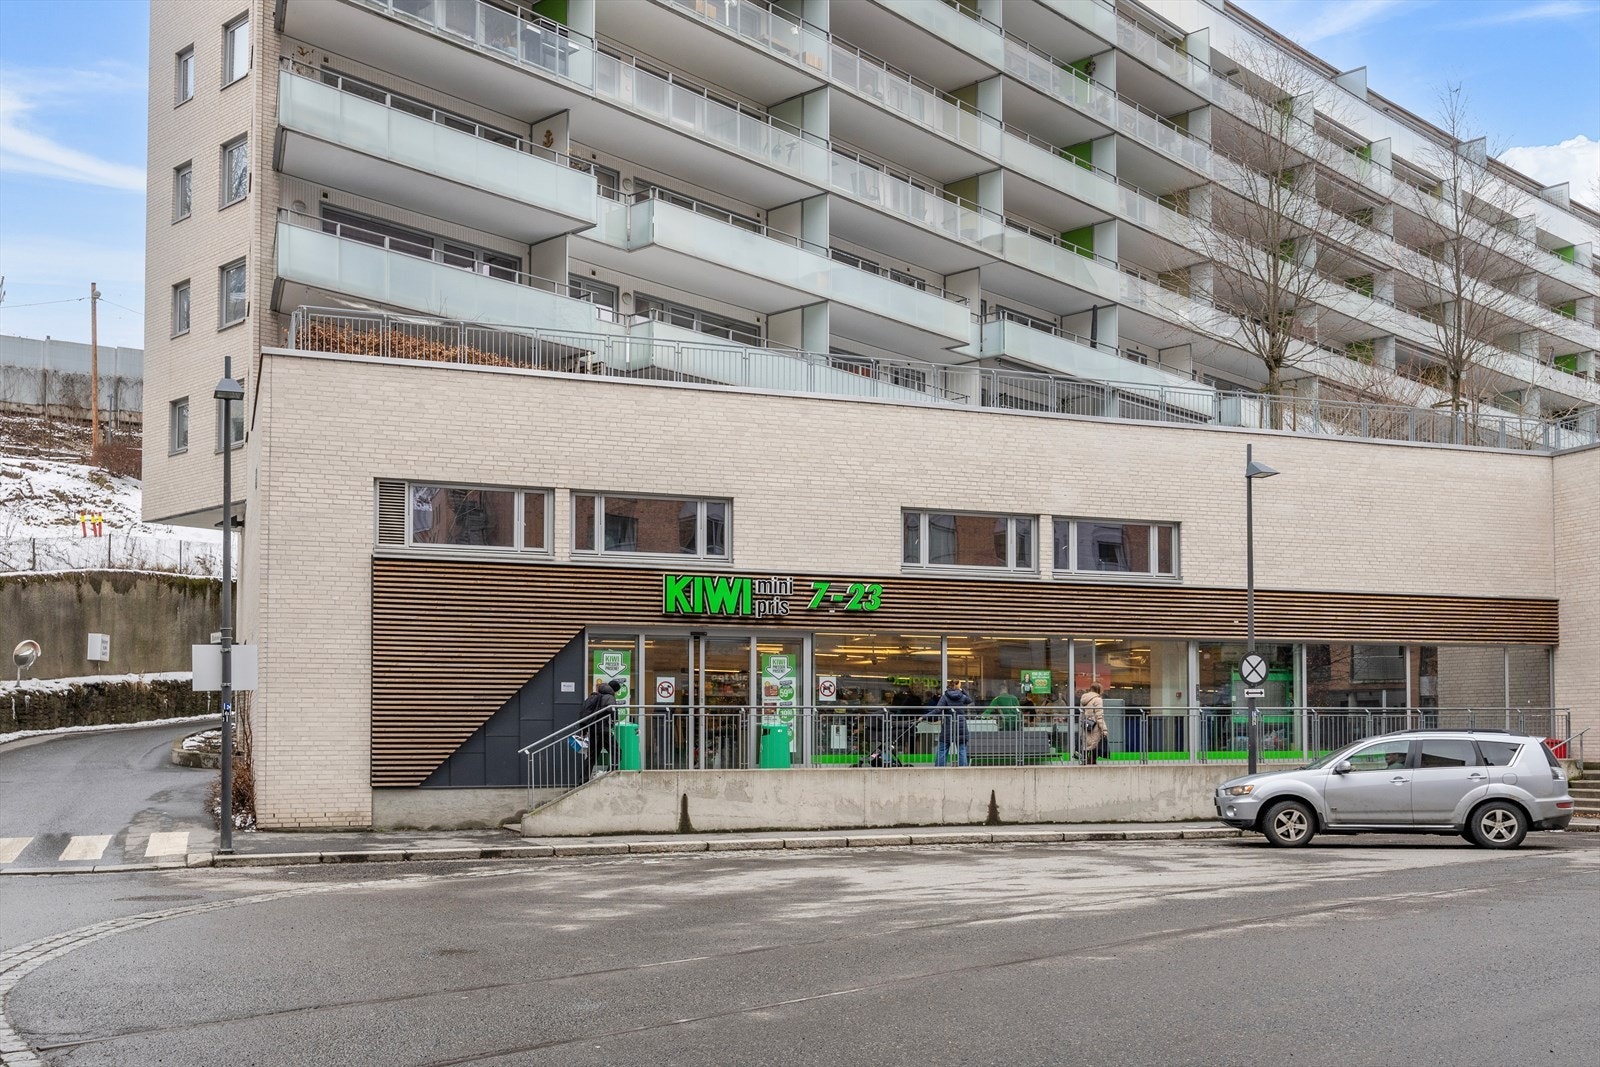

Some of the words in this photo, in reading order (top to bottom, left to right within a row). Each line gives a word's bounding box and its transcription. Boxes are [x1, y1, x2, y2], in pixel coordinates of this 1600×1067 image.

[663, 574, 753, 616] KIWI
[755, 576, 794, 595] mini
[755, 597, 790, 618] pris
